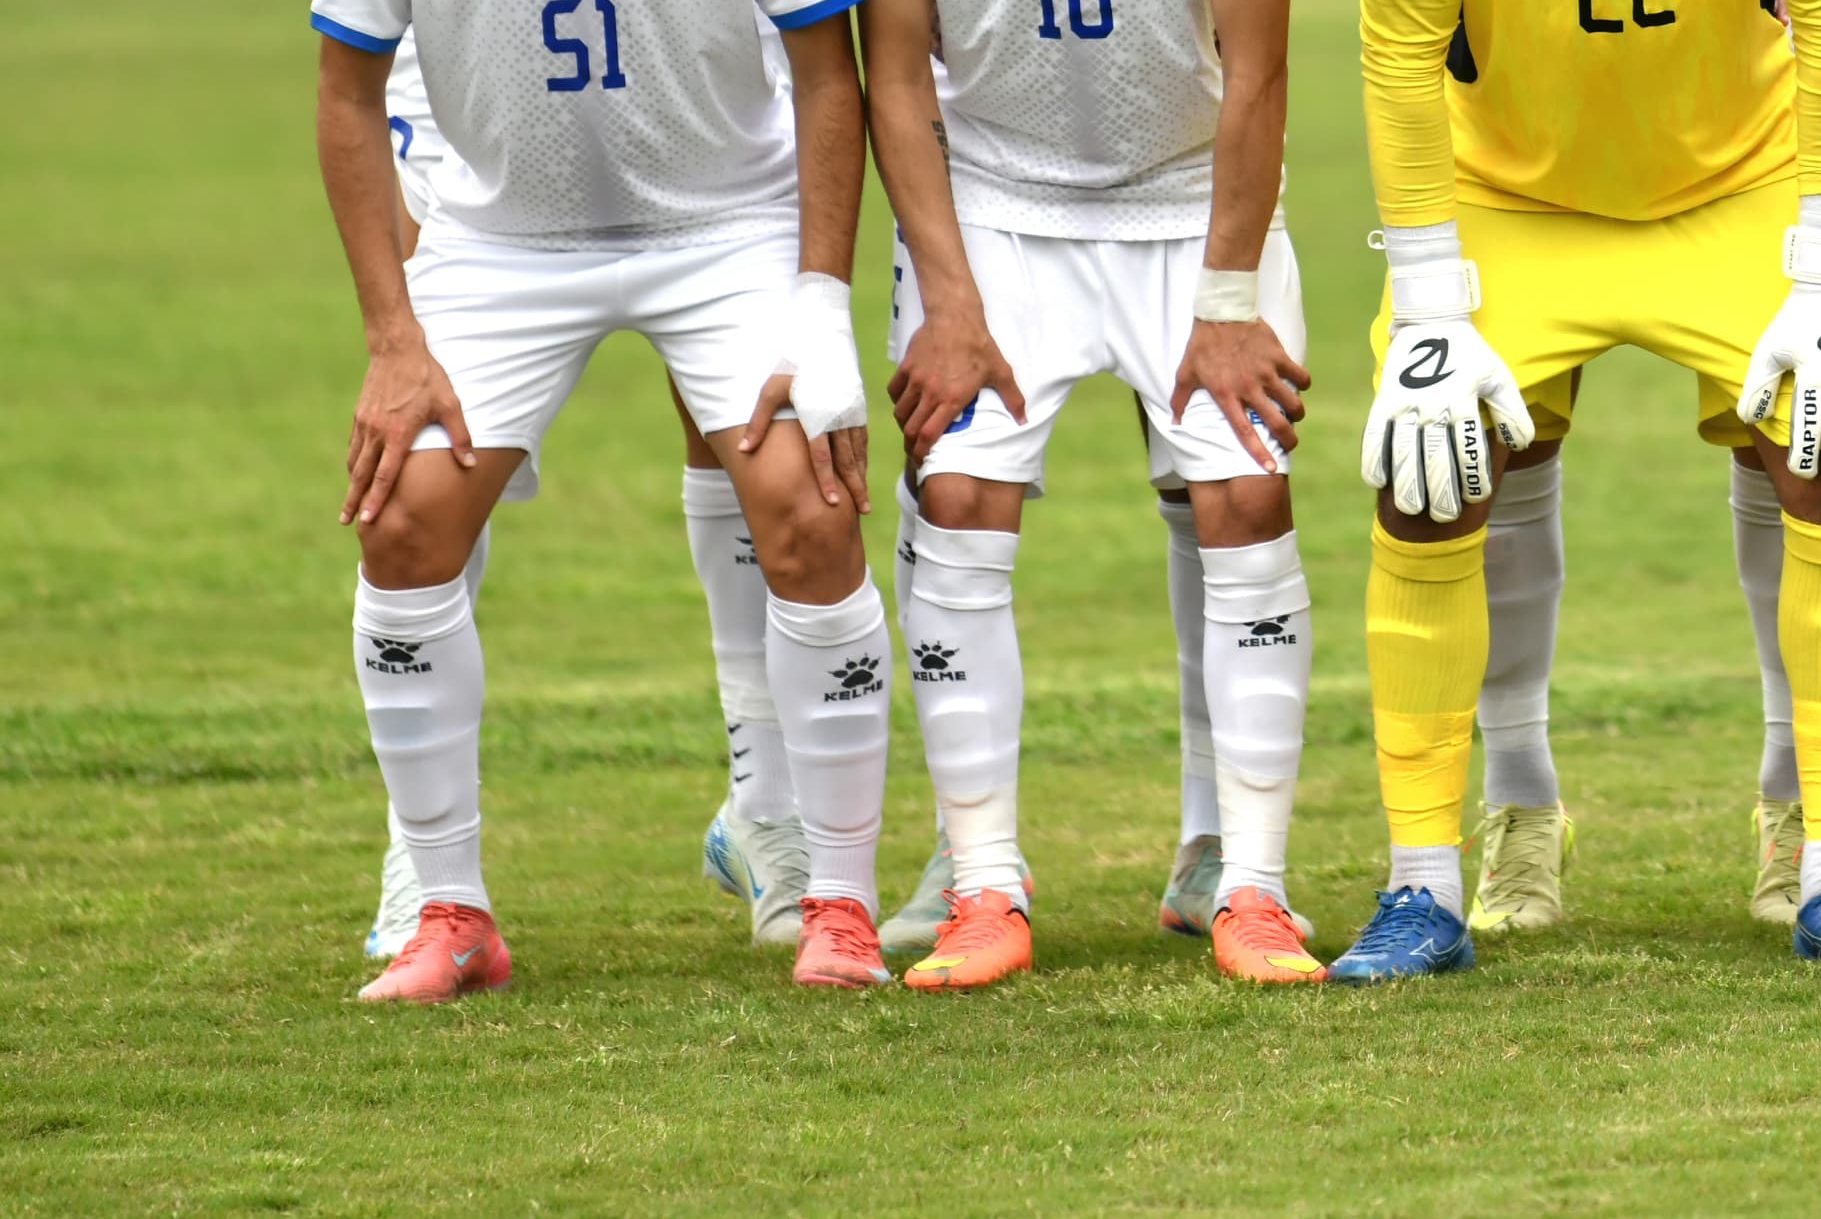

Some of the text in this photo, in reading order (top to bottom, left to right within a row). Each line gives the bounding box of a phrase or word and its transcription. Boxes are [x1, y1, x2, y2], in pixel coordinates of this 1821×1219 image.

[1799, 389, 1817, 470] RAPTOR
[1464, 419, 1482, 496] RAPTOR
[1238, 633, 1297, 649] KELME
[366, 656, 432, 674] KELME
[912, 671, 967, 682] KELME
